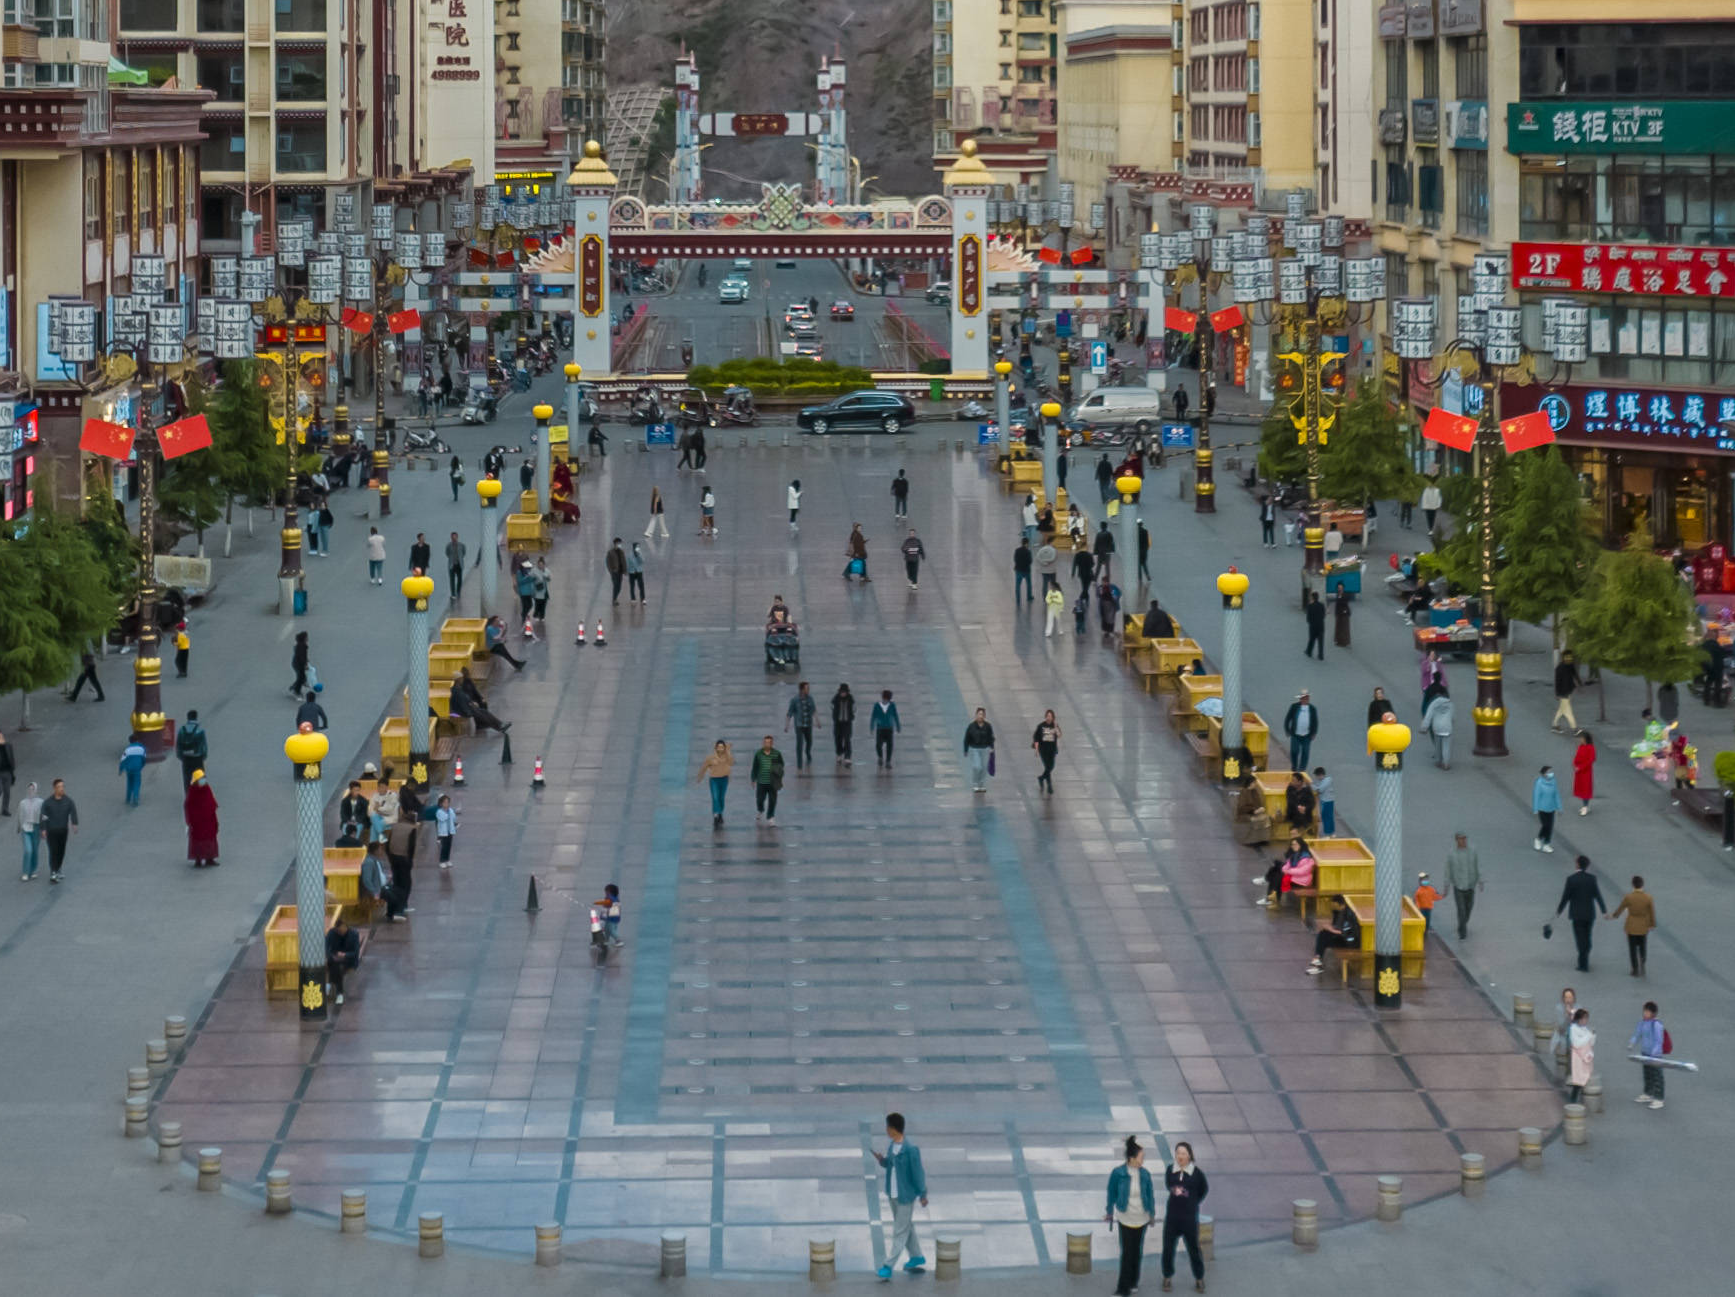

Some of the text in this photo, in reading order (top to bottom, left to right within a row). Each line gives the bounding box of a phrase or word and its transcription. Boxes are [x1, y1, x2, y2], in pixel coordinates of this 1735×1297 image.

[1552, 110, 1609, 144] 錢柜
[1612, 120, 1664, 136] KTV 3F
[1528, 253, 1562, 275] 2F
